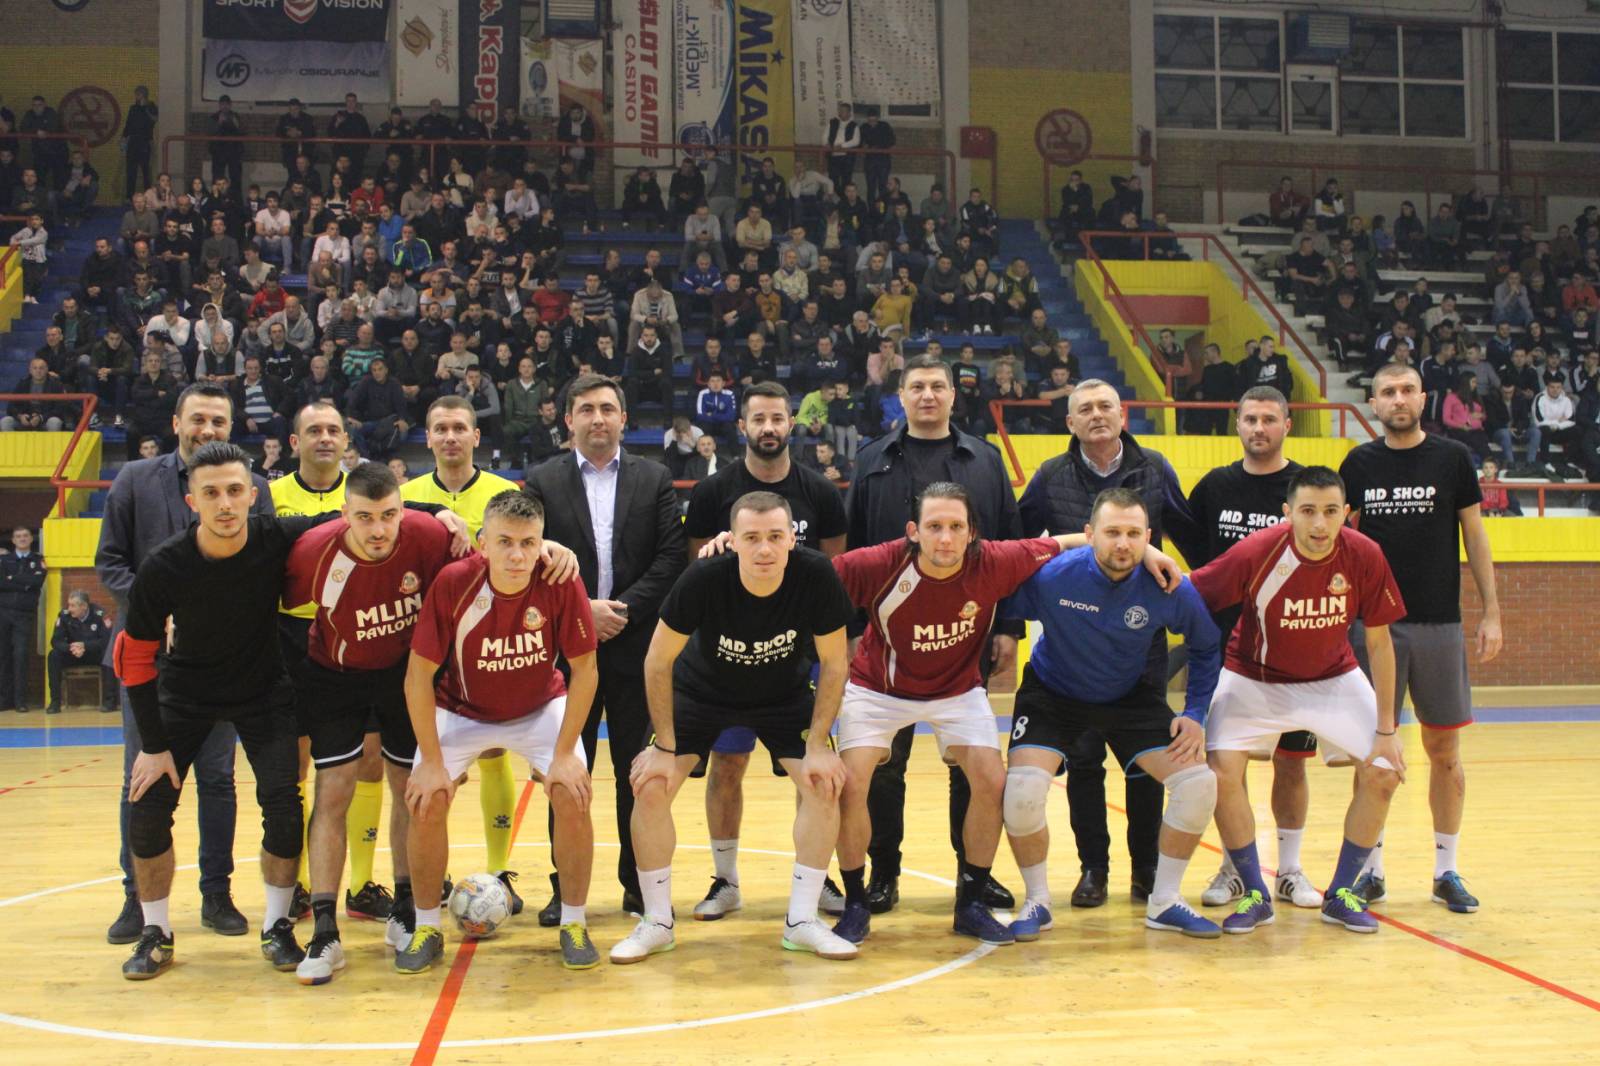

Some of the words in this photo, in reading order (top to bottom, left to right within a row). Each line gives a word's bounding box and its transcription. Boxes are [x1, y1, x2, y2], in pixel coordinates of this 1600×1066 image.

[322, 0, 384, 9] VISION
[624, 33, 637, 123] CASINO
[639, 74, 659, 159] GAME
[1364, 487, 1387, 502] MD
[1392, 486, 1436, 500] SHOP
[1218, 509, 1243, 524] MD
[355, 592, 422, 628] MLIN
[1059, 598, 1100, 613] GIVOVA
[1283, 595, 1347, 617] MLIN
[355, 613, 418, 641] PAVLOVI
[913, 616, 976, 640] MLIN
[480, 630, 544, 658] MLIN
[719, 634, 747, 653] MD
[753, 629, 797, 654] SHOP
[477, 647, 548, 672] PAVLOVIĆ
[1012, 715, 1029, 740] 8
